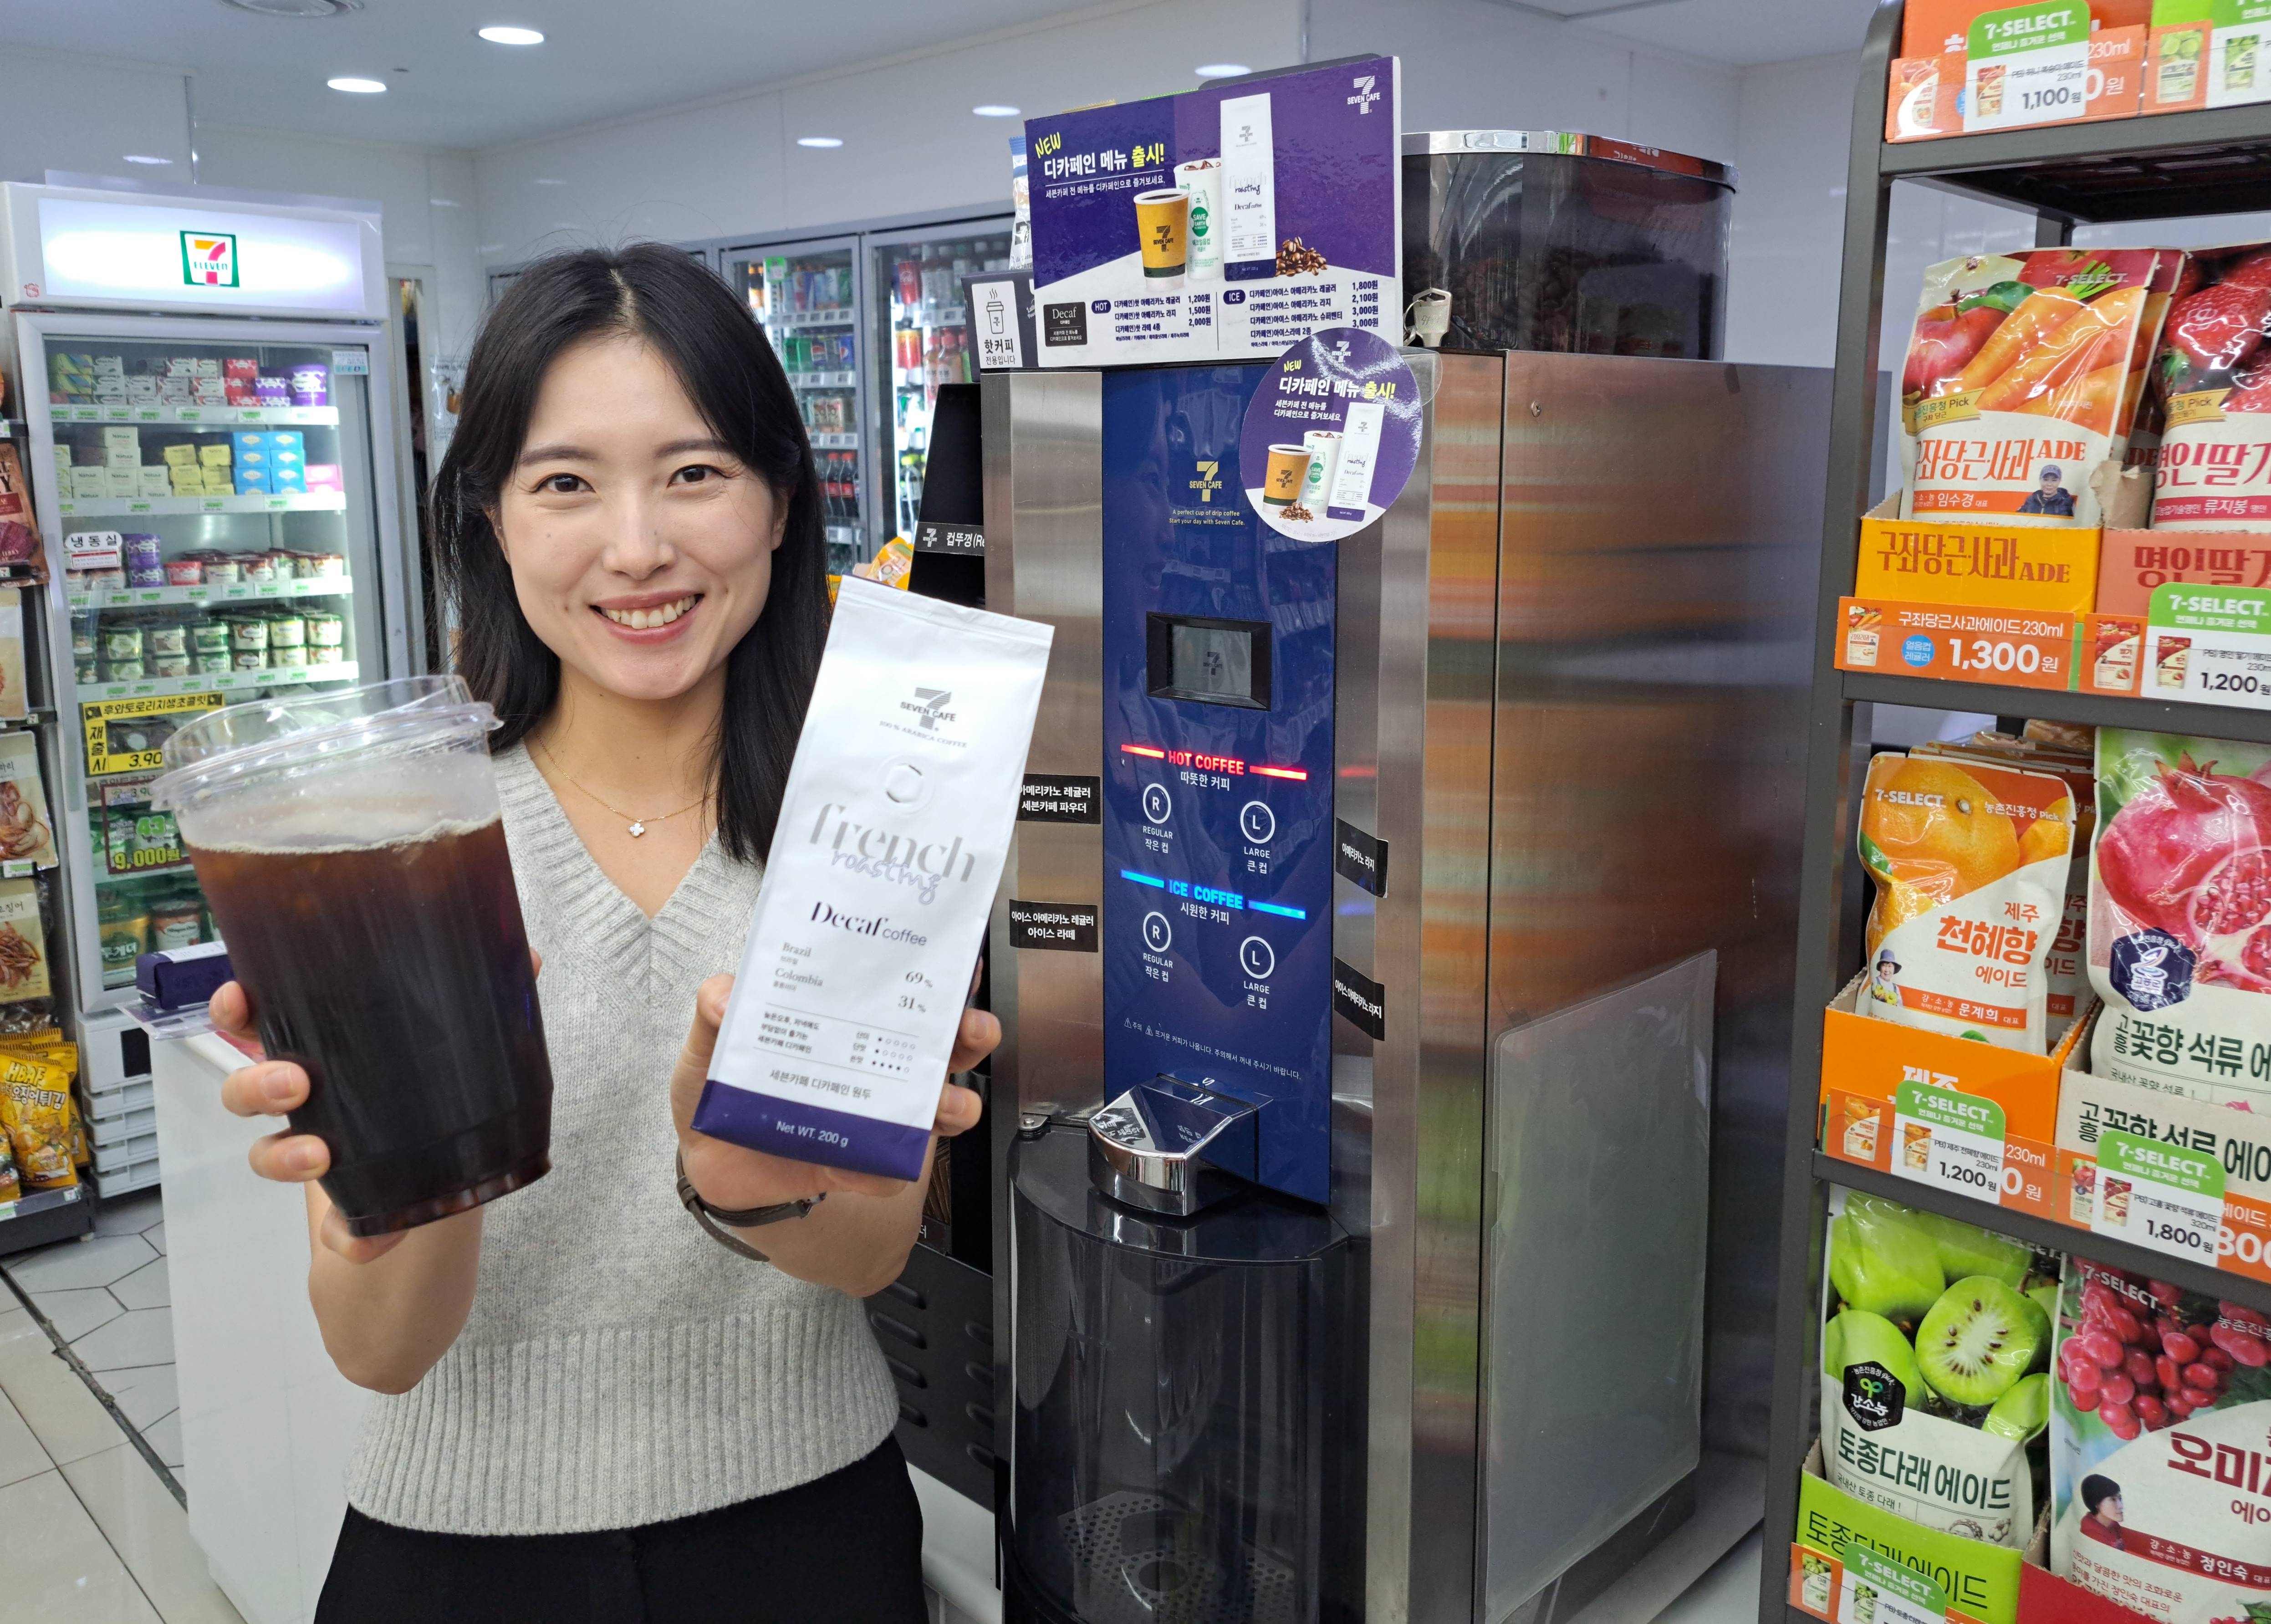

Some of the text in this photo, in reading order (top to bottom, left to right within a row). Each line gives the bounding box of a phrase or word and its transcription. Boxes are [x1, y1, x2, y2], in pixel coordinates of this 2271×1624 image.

[1984, 9, 2072, 41] 7-SELECT
[2057, 71, 2082, 82] 230ml
[1347, 92, 1380, 105] SEVEN CAFE
[1035, 132, 1061, 158] NEW
[1045, 143, 1164, 179] 디카페인 메뉴 출시!
[1046, 189, 1068, 199] 세븐카페
[1070, 186, 1076, 195] 전
[1077, 184, 1094, 194] 메뉴를
[1096, 179, 1132, 191] 디카페인으로
[1235, 202, 1251, 210] Decaf
[1352, 280, 1378, 291] 1,800원
[2056, 272, 2124, 285] 7-SELECT
[1189, 294, 1210, 304] 1,200원
[1229, 292, 1240, 302] ICE
[1352, 293, 1378, 304] 2,100원
[1052, 306, 1077, 319] Decaf
[1095, 302, 1107, 311] HOT
[1189, 306, 1210, 316] 1,500원
[1352, 306, 1378, 317] 3,000원
[1189, 317, 1211, 327] 2,000원
[1352, 318, 1378, 328] 3,000원
[985, 338, 1013, 353] 핫커피
[986, 355, 1015, 365] 전용입니다
[1284, 359, 1301, 373] NEW
[1279, 377, 1396, 400] 디카페인 메뉴 출시!
[1275, 399, 1327, 411] 세븐카페 전 메뉴를
[2187, 397, 2212, 408] Pick
[1938, 493, 1975, 507] 임수경
[2204, 500, 2248, 514] 류지봉
[2169, 595, 2265, 617] 7-SELECT
[1905, 640, 1931, 651] 얼음컵
[1905, 652, 1931, 662] 레귤러
[900, 701, 956, 722] SEVEN CAFE
[1168, 750, 1244, 776] HOT COFFEE
[1180, 771, 1230, 792] 따뜻한 커피
[1152, 796, 1160, 811] R
[1874, 787, 1944, 809] 7-SELECT
[1021, 801, 1087, 813] 세븐카페 파우더
[1984, 801, 2059, 821] 농촌진흥청 Pick
[1252, 815, 1261, 830] L
[1143, 825, 1173, 839] REGULAR
[809, 802, 976, 883] french
[1145, 838, 1169, 854] 작은 컵
[1244, 846, 1270, 859] LARGE
[1342, 842, 1374, 872] 아메리카노 라지
[1247, 860, 1267, 874] 큰 컵
[1169, 879, 1244, 910] ICE COFFEE
[1011, 911, 1094, 926] 아이스 아메리카노 레귤러
[1180, 902, 1230, 925] 시원한 커피
[2003, 901, 2040, 924] 제주
[810, 900, 928, 946] Decaf coffee
[1028, 927, 1076, 940] 아이스 라떼
[1152, 925, 1160, 940] R
[1936, 915, 2039, 966] 천혜향
[782, 942, 812, 958] Brazil
[1252, 950, 1260, 965] L
[1143, 952, 1173, 969] REGULAR
[775, 967, 823, 987] Colombia
[1145, 965, 1169, 982] 작은 컵
[1975, 965, 2027, 988] 에이드
[1244, 981, 1270, 995] LARGE
[1247, 994, 1267, 1010] 큰 컵
[1335, 979, 1381, 1019] 아이스 아메리카노 라지
[1133, 1021, 1301, 1080] 주의 뜨거운 커피가 나옵니다. 주의해서 꺼내 주시기 바랍니다.
[770, 1069, 872, 1100] 세븐카페 디카페인 원두
[1912, 1089, 1990, 1123] 7-SELECT
[1918, 1108, 1985, 1133] 언제나 즐거운 선택
[776, 1121, 848, 1148] Net WT. 200 g
[2006, 1144, 2046, 1168] 230ml
[2116, 1141, 2206, 1177] 7-SELECT
[1975, 1159, 1998, 1172] 230ml
[2190, 1218, 2216, 1232] 320ml
[2083, 1264, 2159, 1311] 7-SELECT
[1839, 1427, 2011, 1510] 토종다래 에이드
[1858, 1553, 1931, 1596] 7-SELECT
[2200, 1555, 2249, 1581] 정인숙
[2254, 1574, 2271, 1584] 대표
